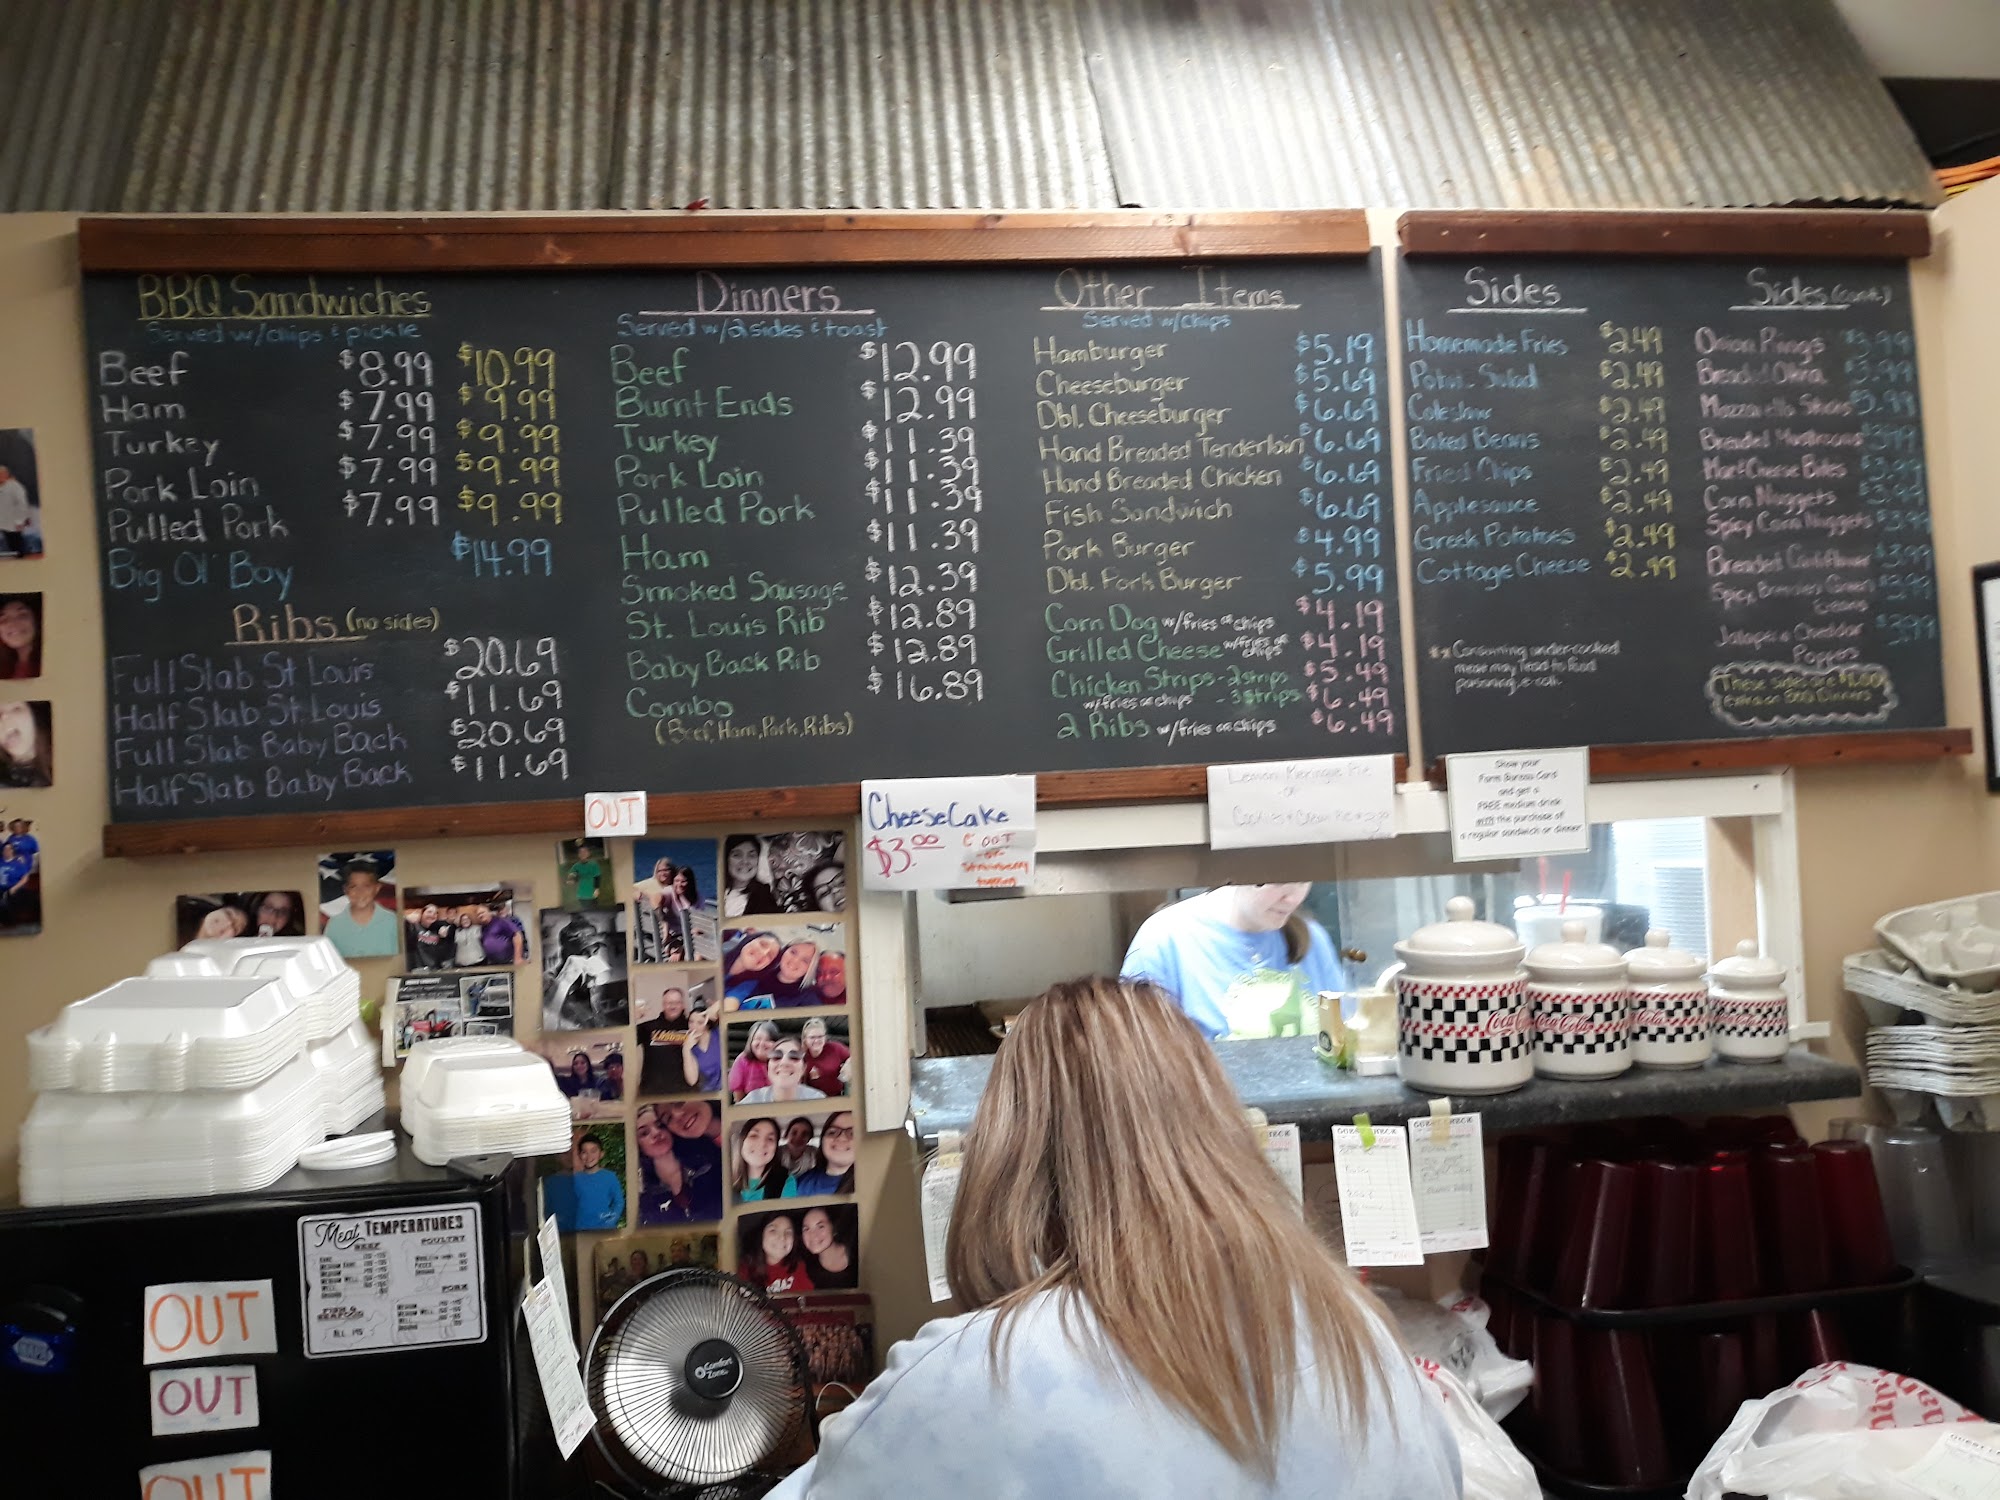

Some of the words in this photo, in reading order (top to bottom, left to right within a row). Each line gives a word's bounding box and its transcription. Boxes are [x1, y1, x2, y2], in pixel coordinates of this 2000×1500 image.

[137, 273, 219, 318] BBQ
[230, 275, 432, 317] Sandwiches
[695, 269, 842, 313] Dinners
[1054, 267, 1155, 309] Other
[1181, 265, 1285, 308] Items
[1464, 265, 1562, 306] Sides
[1747, 267, 1828, 306] Sides
[145, 322, 225, 343] Served
[616, 312, 697, 339] Served
[1082, 311, 1153, 330] Served
[1033, 335, 1170, 372] Hamburger
[1295, 330, 1375, 366] $5.19
[1520, 329, 1570, 355] Fries
[100, 351, 190, 386] Beef
[339, 348, 434, 387] $8.99
[458, 342, 556, 389] $10.99
[609, 343, 690, 386] Beef
[858, 340, 979, 383] $12.99
[1035, 370, 1191, 402] Cheeseburger
[1294, 363, 1377, 396] $5.69
[102, 395, 186, 424] Ham
[339, 388, 434, 421] $7.99
[458, 384, 556, 422] $9.99
[615, 385, 707, 419] Burnt
[716, 386, 795, 419] Ends
[859, 379, 978, 423] $12.99
[1088, 402, 1232, 438] Cheeseburger
[1294, 391, 1380, 422] $6.69
[105, 432, 220, 466] Turkey
[338, 420, 436, 453] $7.99
[456, 418, 560, 454] $9.99
[613, 424, 719, 463] Turkey
[860, 419, 977, 456] $11.39
[1038, 434, 1102, 463] Hand
[1107, 434, 1192, 464] Breaded
[1299, 423, 1381, 455] $6.69
[1472, 426, 1541, 450] Beans
[104, 467, 178, 502] Pork
[189, 467, 259, 499] Loin
[338, 455, 438, 487] $7.99
[455, 450, 561, 486] $9.99
[614, 455, 689, 489] Pork
[699, 461, 764, 490] Loin
[863, 447, 980, 487] $11.39
[1042, 467, 1102, 495] Hand
[1106, 467, 1193, 494] Breaded
[1200, 464, 1283, 488] Chicken
[1299, 455, 1381, 486] $6.69
[107, 508, 206, 543] Pulled
[222, 502, 290, 540] Pork
[342, 489, 440, 526] $7.99
[457, 485, 564, 527] $9.99
[616, 492, 727, 526] Pulled
[739, 490, 817, 526] Pork
[865, 477, 983, 515] $11.39
[1045, 499, 1103, 526] Fish
[1110, 498, 1233, 525] Sandwich
[1299, 487, 1381, 524] $6.69
[621, 532, 710, 571] Ham
[866, 517, 981, 553] $11.39
[1042, 528, 1103, 560] Pork
[1111, 531, 1195, 566] Burger
[1295, 526, 1381, 559] $4.99
[1484, 522, 1576, 547] Potatoes
[108, 547, 165, 602] Big
[229, 550, 294, 600] Boy
[451, 532, 553, 578] $14.99
[620, 574, 737, 606] Smoked
[865, 556, 978, 598] $12.39
[1101, 567, 1155, 592] Pork
[1159, 566, 1243, 600] Burger
[1291, 556, 1385, 594] $5.99
[1417, 558, 1515, 591] Cottage
[1516, 552, 1592, 577] Cheese
[232, 603, 340, 641] Ribs
[345, 606, 380, 635] (no
[383, 606, 441, 633] sides)
[689, 609, 768, 640] Louis
[776, 605, 827, 636] Rib
[866, 595, 977, 631] $12.89
[1045, 603, 1104, 634] Corn
[1108, 603, 1159, 641] Dog
[111, 654, 177, 695] Full
[183, 653, 252, 692] Slab
[443, 636, 559, 681] $20.69
[627, 649, 700, 688] Baby
[705, 649, 769, 677] Back
[776, 645, 822, 672] Rib
[866, 630, 978, 665] $12.89
[1045, 638, 1132, 664] Grilled
[1137, 635, 1225, 662] Cheese
[312, 693, 382, 720] Louis
[443, 679, 564, 716] $11.69
[625, 686, 735, 719] Combo
[866, 665, 984, 703] $16.89
[1051, 669, 1142, 699] Chicken
[1146, 665, 1215, 694] Strips
[1304, 660, 1388, 684] $5.49
[1306, 681, 1389, 709] $6.49
[114, 738, 176, 768] Full
[333, 722, 409, 754] Back
[450, 716, 567, 751] $20.69
[1057, 712, 1080, 740] 2
[1089, 712, 1150, 739] Ribs
[1310, 708, 1394, 735] $6.49
[114, 772, 188, 807] Half
[186, 774, 254, 803] Slab
[265, 765, 337, 801] Baby
[342, 757, 414, 786] Back
[451, 749, 569, 783] $11.69
[587, 797, 641, 830] OUT
[868, 791, 1010, 831] CheeseCake
[314, 1220, 365, 1250] Meat
[365, 1215, 464, 1237] TEMPERATURES
[150, 1290, 260, 1353] OUT
[158, 1375, 252, 1416] OUT
